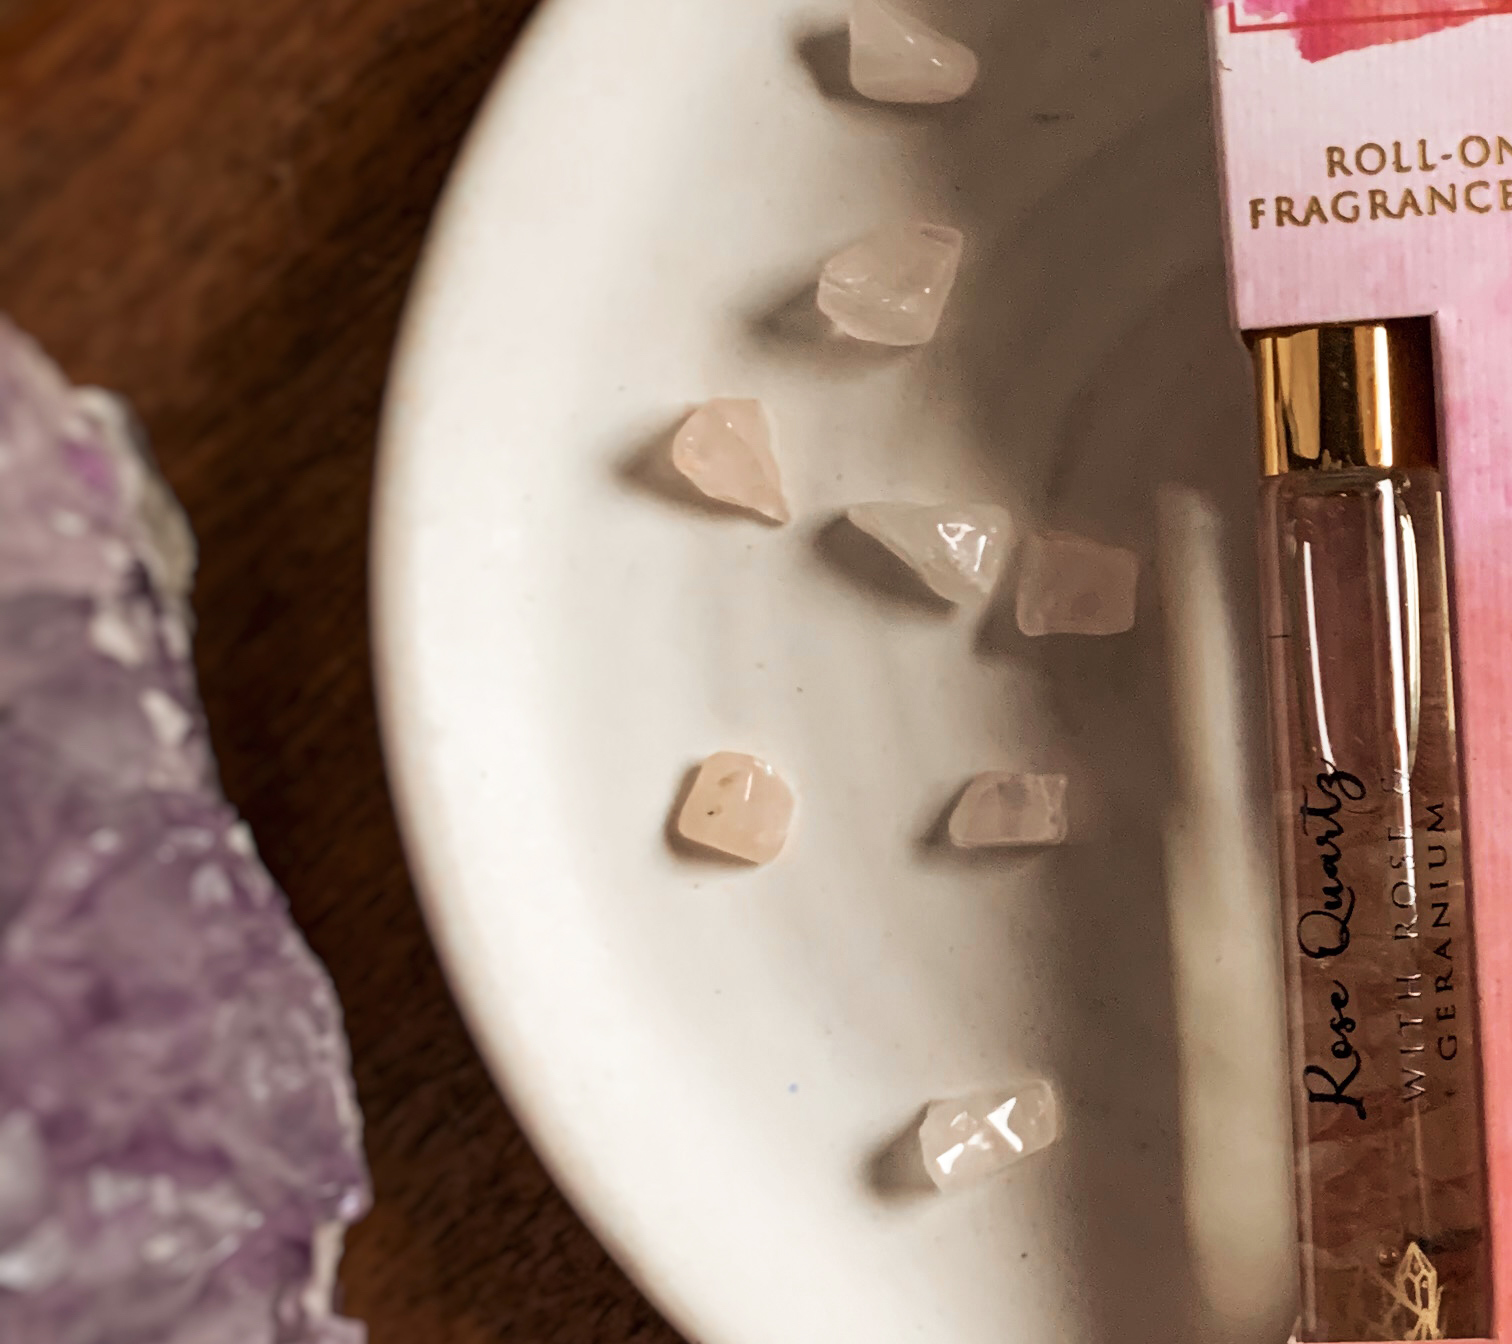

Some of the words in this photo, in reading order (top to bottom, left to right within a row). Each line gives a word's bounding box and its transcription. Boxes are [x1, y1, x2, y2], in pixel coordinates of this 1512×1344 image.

[1297, 757, 1366, 959] Quartz
[1425, 802, 1458, 1060] GERANIUM
[1303, 979, 1367, 1120] Rose
[1395, 972, 1427, 1103] WITH
